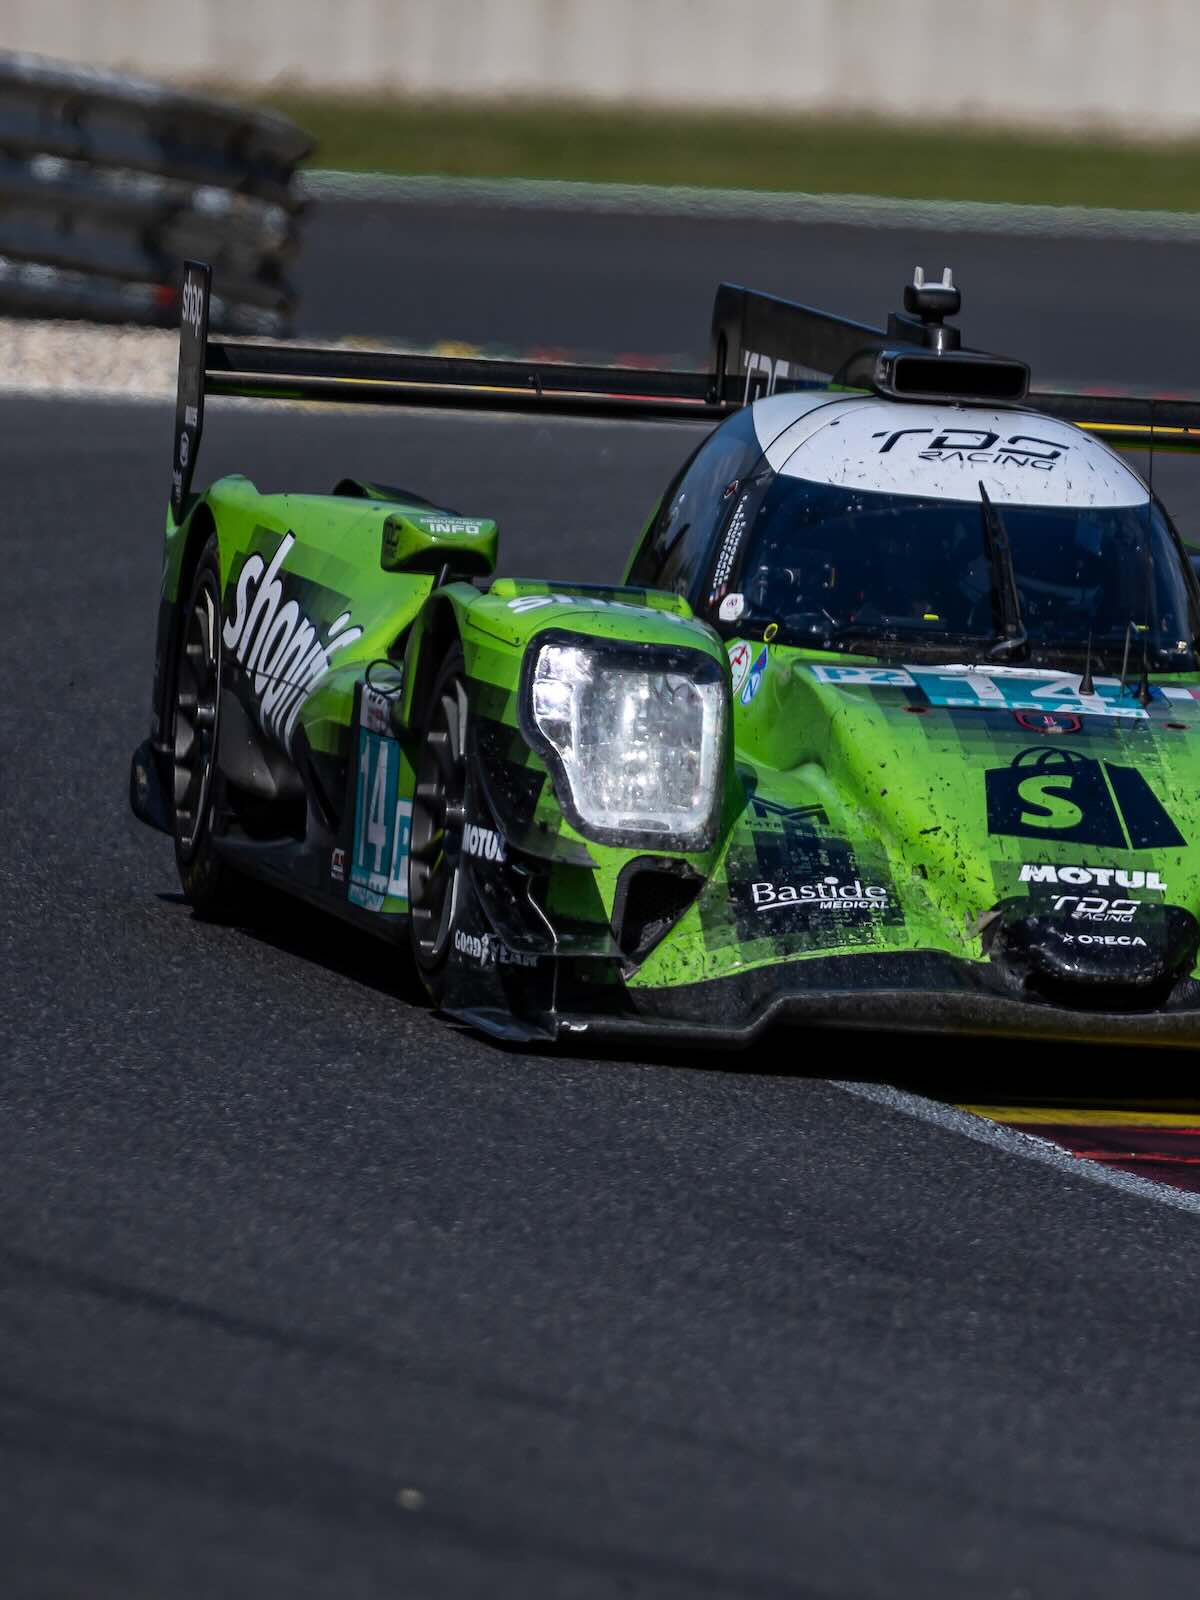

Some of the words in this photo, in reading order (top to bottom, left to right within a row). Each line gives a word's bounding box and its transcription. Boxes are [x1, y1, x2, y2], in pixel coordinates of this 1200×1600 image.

[872, 428, 1071, 460] TDS
[918, 451, 1057, 472] RACING
[430, 523, 480, 534] INFO
[939, 674, 1118, 713] 14
[358, 735, 390, 873] 14
[1018, 775, 1084, 829] S
[1018, 864, 1168, 891] MOTUL
[752, 876, 888, 904] Bastide
[820, 900, 890, 910] MEDICAL
[1051, 895, 1142, 915] TDS
[1071, 912, 1135, 922] RACING
[1078, 934, 1148, 947] ORECA
